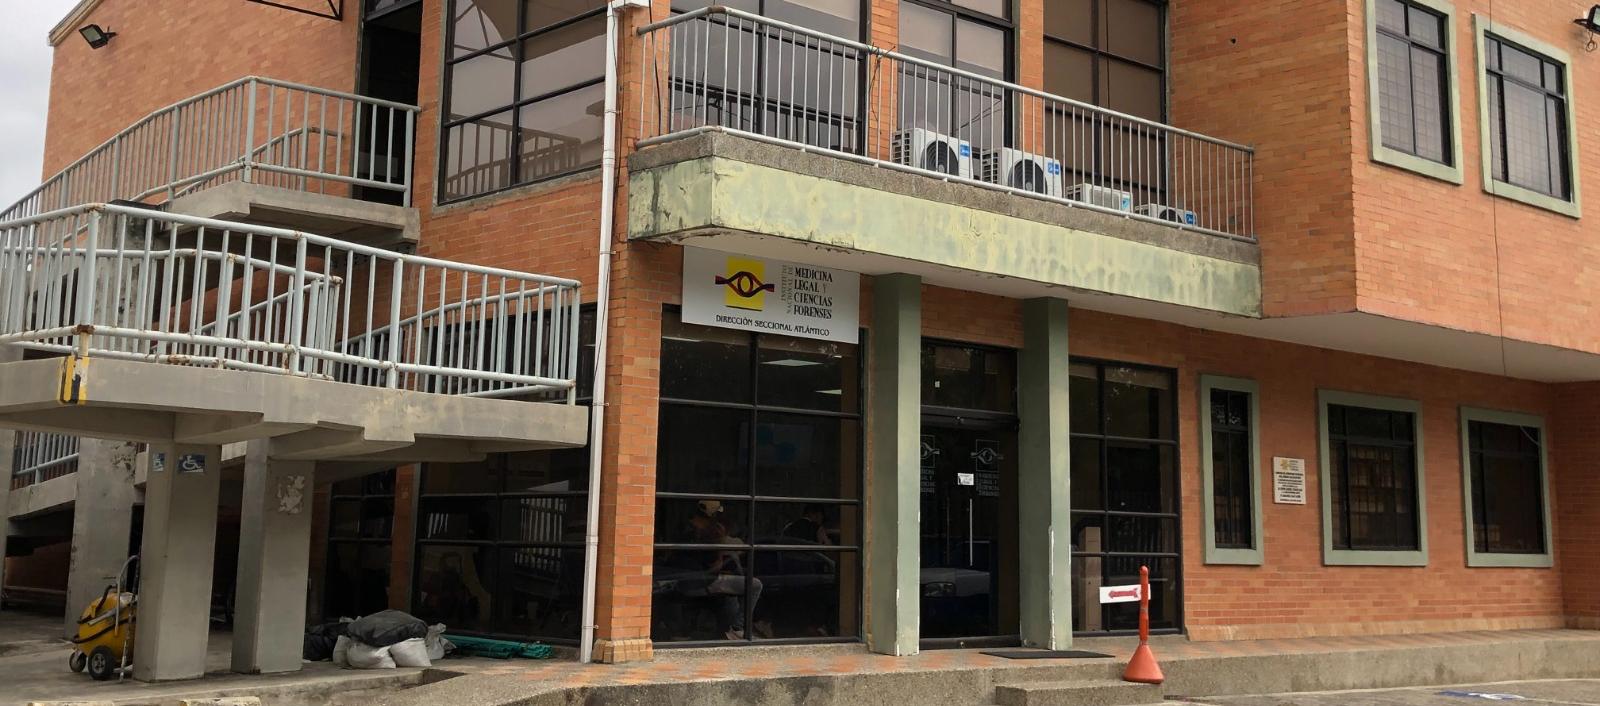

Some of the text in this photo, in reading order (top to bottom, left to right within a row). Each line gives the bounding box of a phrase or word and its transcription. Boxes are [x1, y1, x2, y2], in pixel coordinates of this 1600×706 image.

[794, 267, 833, 282] MEDICINA
[794, 279, 828, 293] LEGAL Y
[793, 292, 833, 307] CIENCIAS
[793, 305, 832, 319] FORENSES
[716, 314, 830, 337] DIRECCIÓN SECCIONAL ATLÁNTICO
